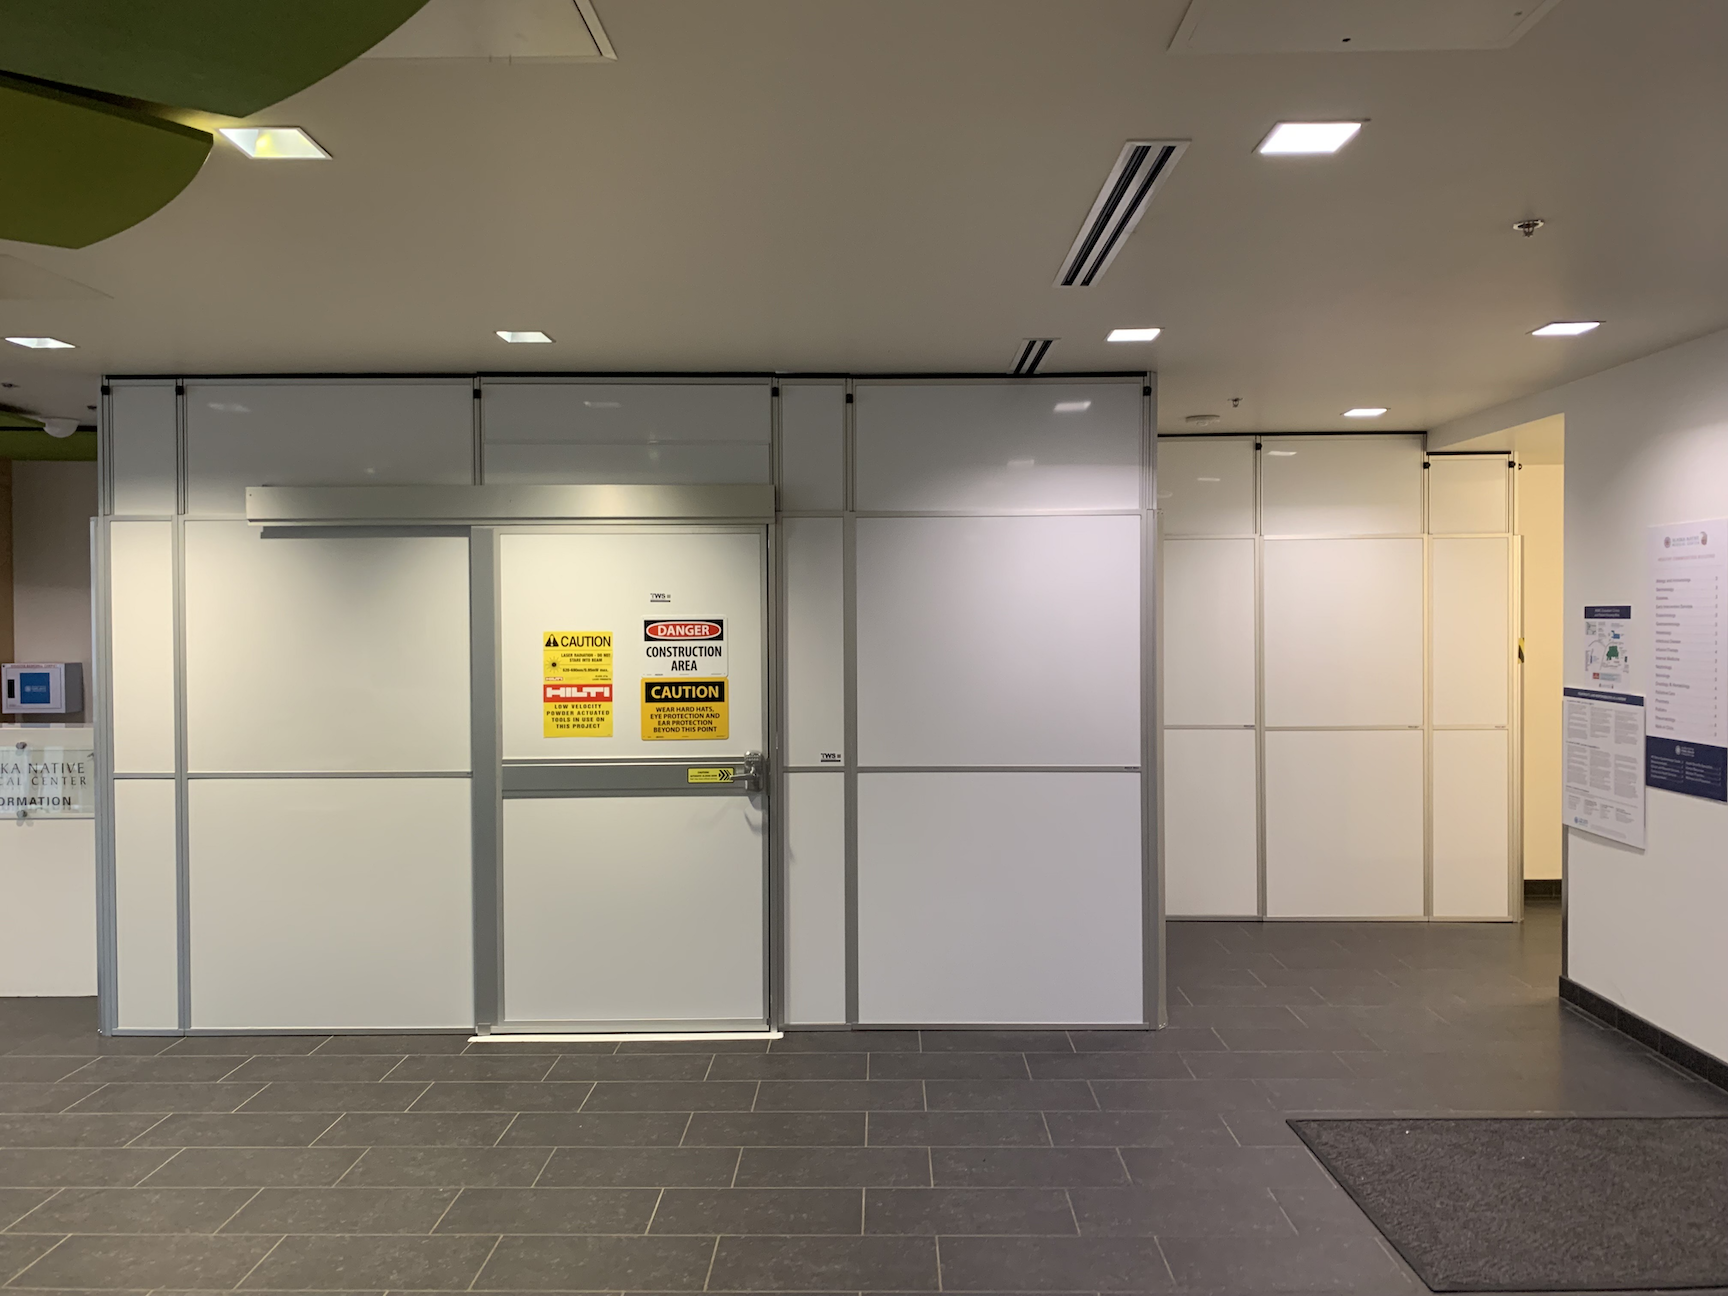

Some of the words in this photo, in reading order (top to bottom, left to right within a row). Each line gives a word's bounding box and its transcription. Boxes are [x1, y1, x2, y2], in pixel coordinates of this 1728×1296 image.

[657, 624, 710, 637] DANGER
[561, 636, 611, 647] CAUTION
[646, 646, 722, 658] CONSTRUCTION
[671, 660, 698, 671] AREA
[546, 687, 610, 698] HILTI
[651, 686, 719, 699] CAUTION
[28, 763, 85, 774] NATIVE
[31, 776, 87, 785] CENTER
